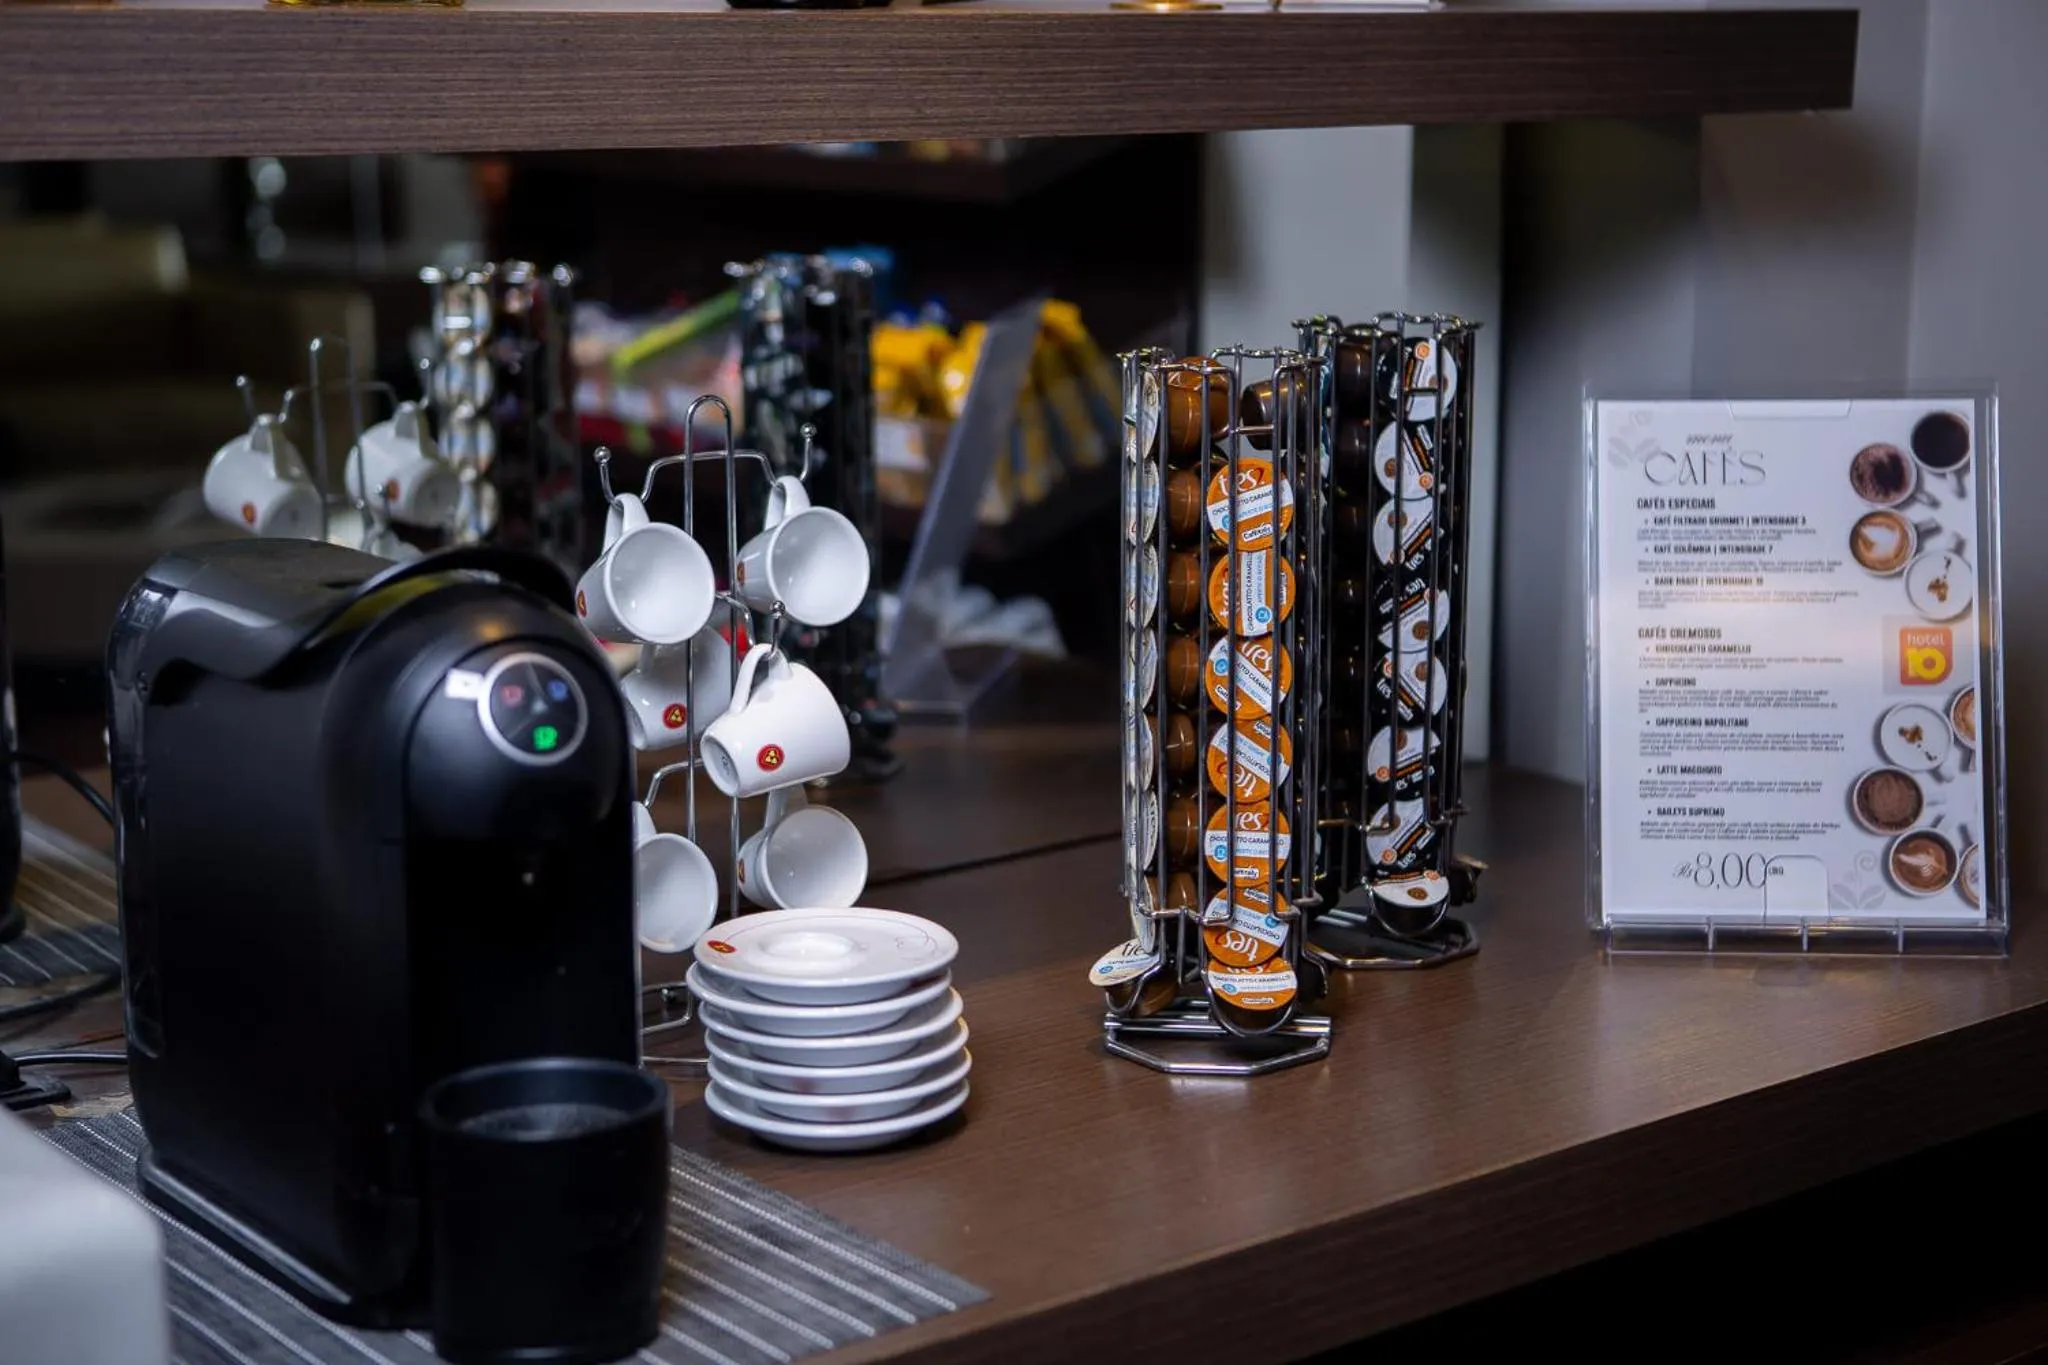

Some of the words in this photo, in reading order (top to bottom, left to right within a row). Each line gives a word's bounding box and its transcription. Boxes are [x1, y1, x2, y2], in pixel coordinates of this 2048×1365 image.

[1644, 446, 1767, 486] CAFÉS
[1637, 496, 1666, 510] CAFÉS
[1668, 497, 1716, 510] ESPECIAIS
[1654, 514, 1671, 525] CAFÉ
[1673, 516, 1707, 525] FILTRADO
[1708, 516, 1744, 525] GOURMET
[1654, 543, 1671, 554] CAFÉ
[1673, 543, 1711, 554] COLÔMBIA
[1719, 545, 1766, 554] INTENSIDADE
[1638, 626, 1667, 639] CAFÉS
[1669, 628, 1722, 639] CREMOSOS
[1907, 632, 1946, 646] hotel
[1657, 765, 1678, 775] LATTE
[1693, 851, 1767, 891] 8,00
[1222, 930, 1259, 963] tres
